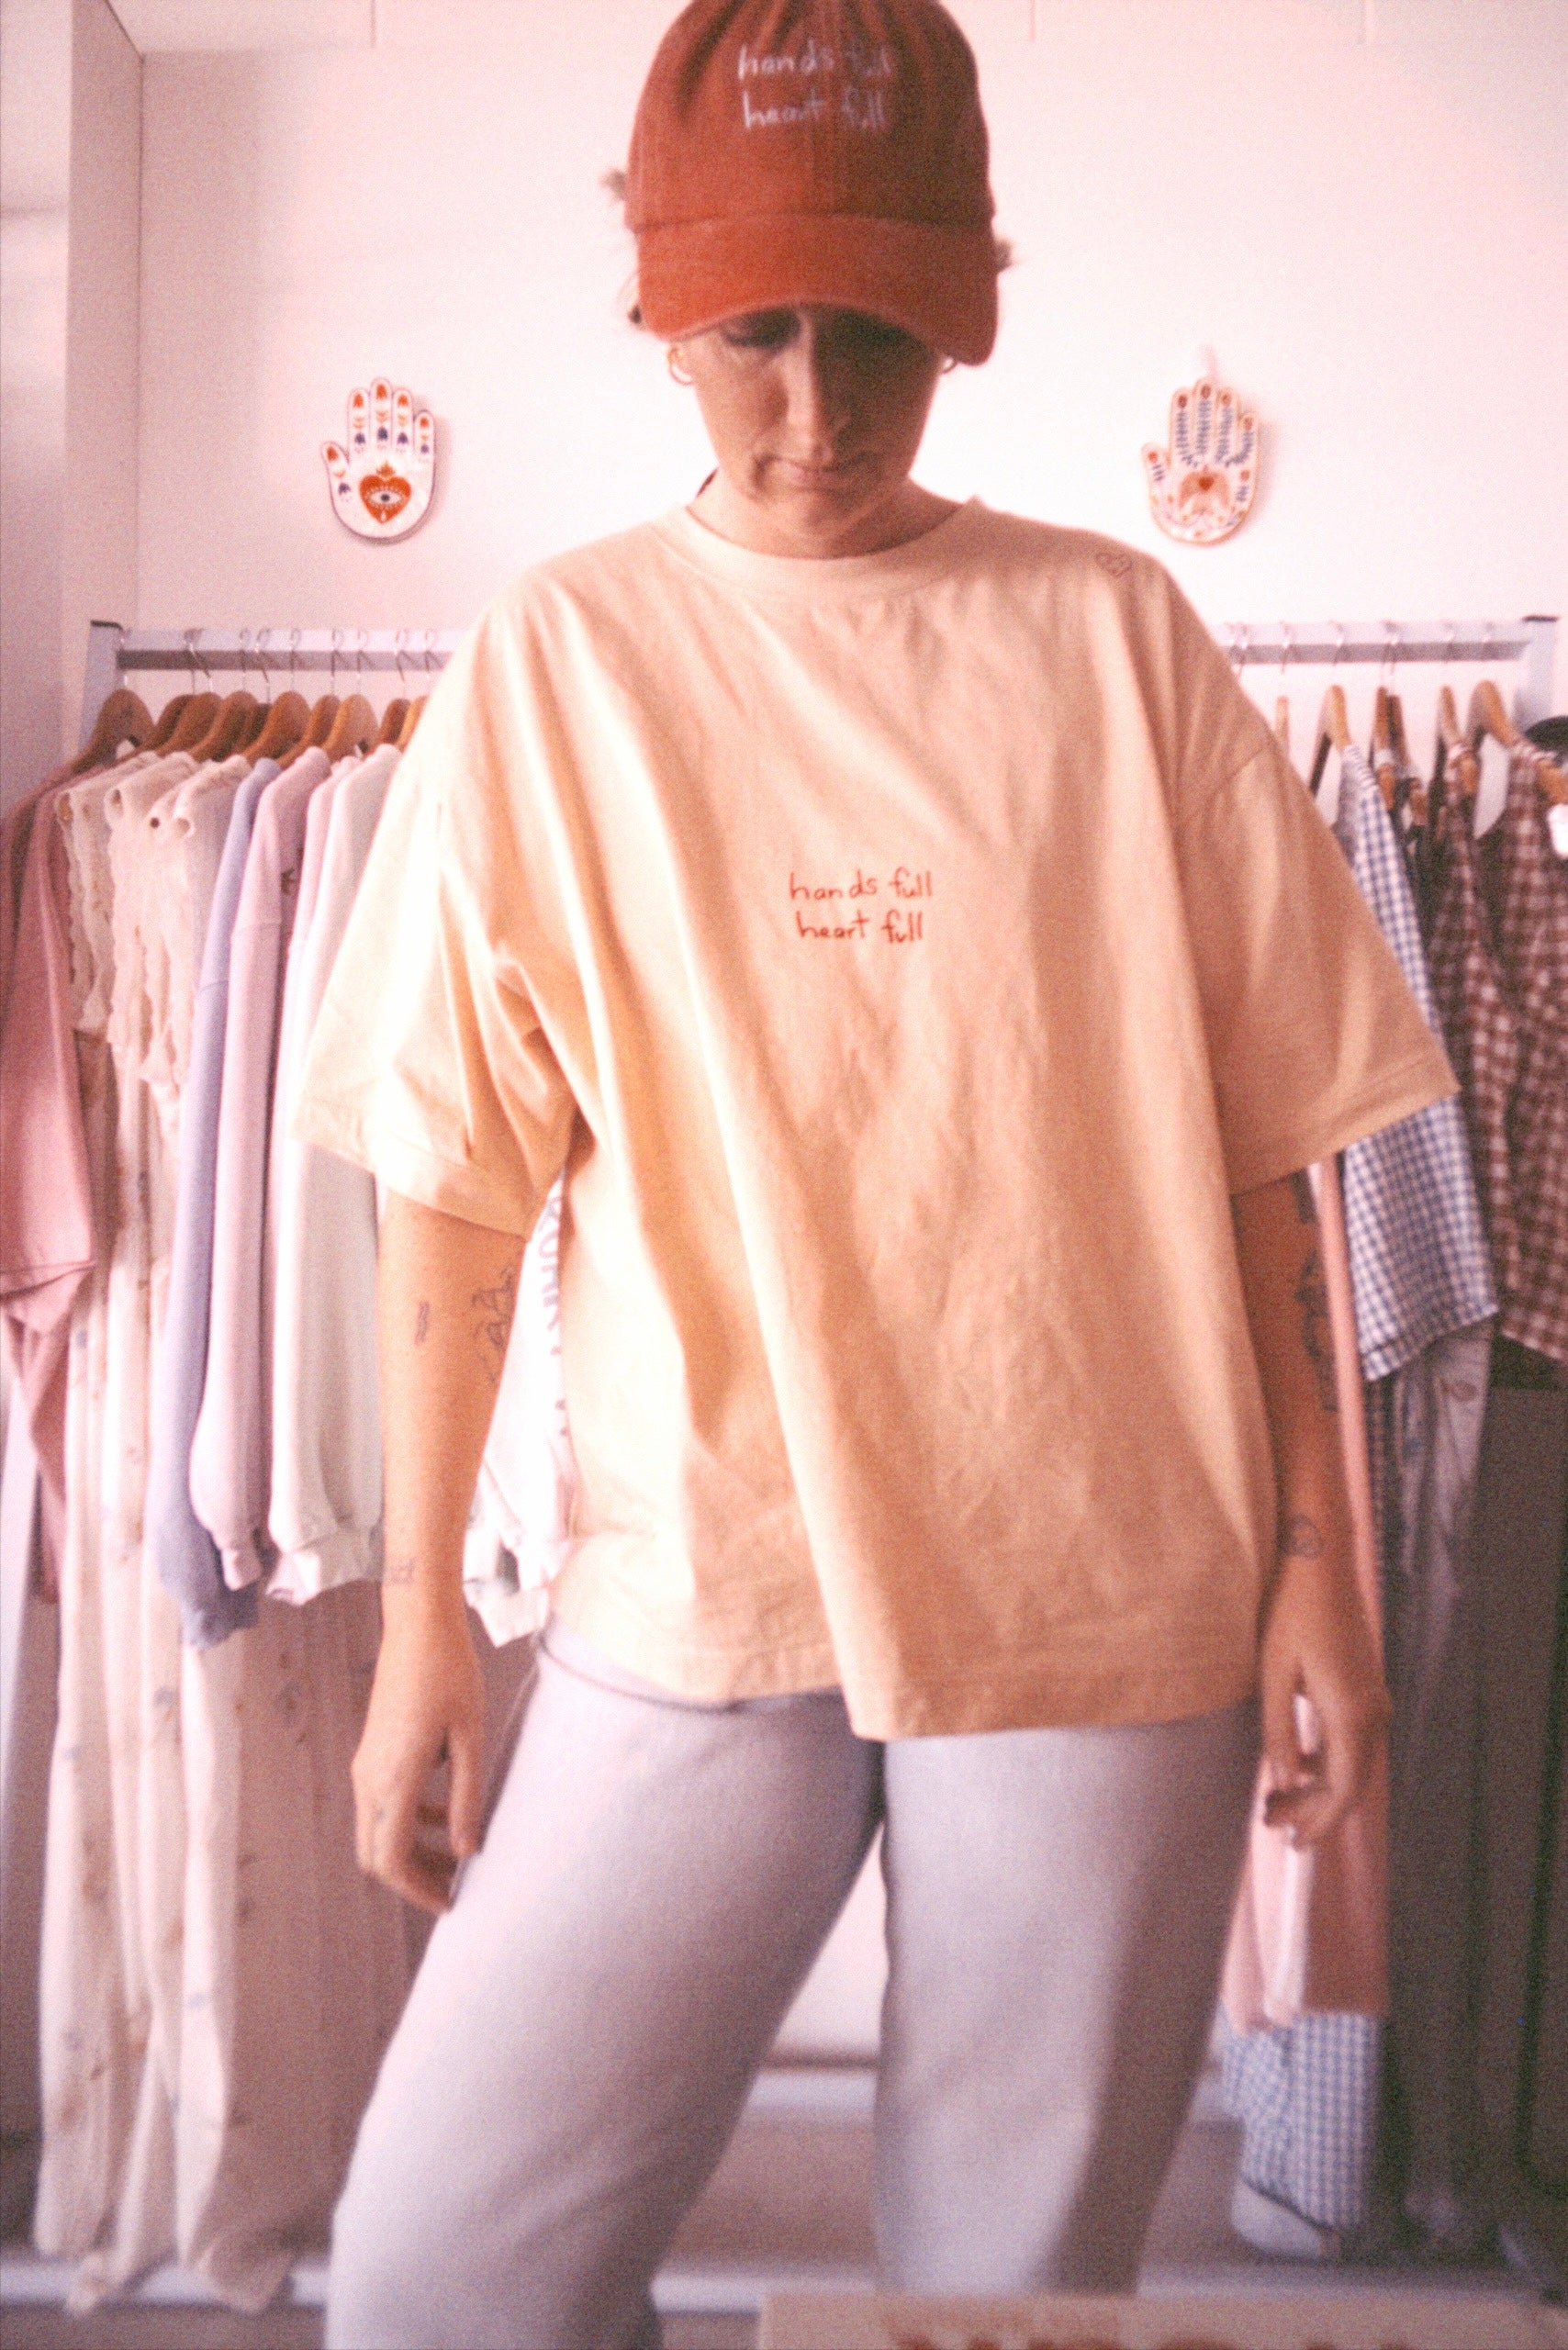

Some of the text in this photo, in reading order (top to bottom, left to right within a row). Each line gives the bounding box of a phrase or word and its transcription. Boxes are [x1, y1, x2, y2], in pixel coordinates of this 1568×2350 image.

[737, 38, 835, 81] hands
[743, 84, 890, 129] heart full
[790, 866, 933, 901] hands full
[796, 908, 923, 944] heart full
